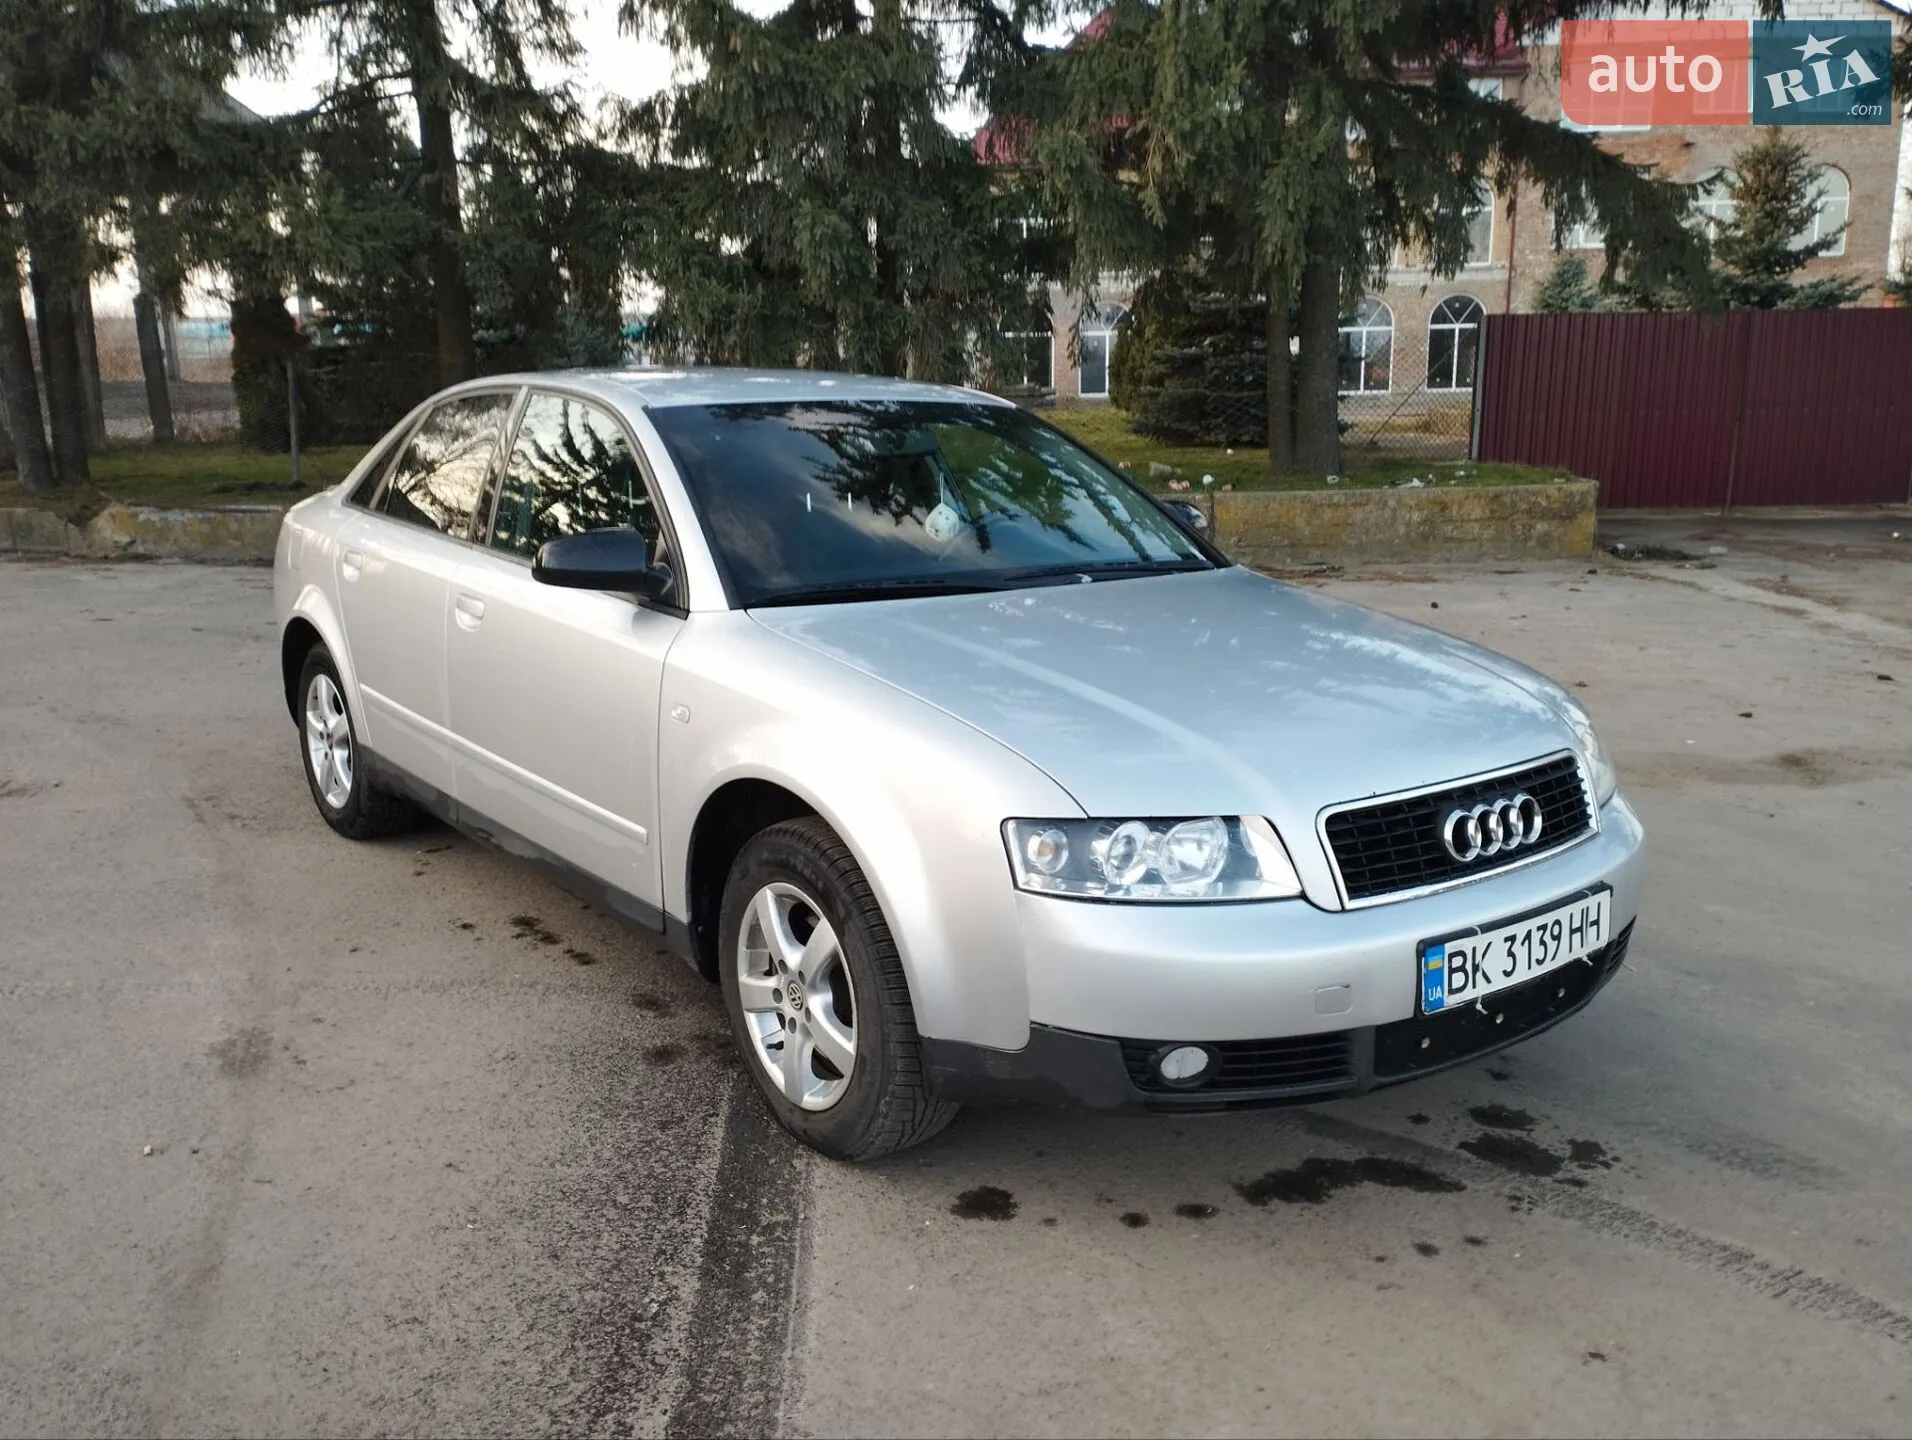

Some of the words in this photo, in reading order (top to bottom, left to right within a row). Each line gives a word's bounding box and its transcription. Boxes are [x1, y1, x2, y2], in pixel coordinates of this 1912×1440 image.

[1448, 941, 1492, 996] BK
[1502, 918, 1563, 978] 3139
[1569, 901, 1601, 954] HH
[1428, 986, 1443, 1001] UA
